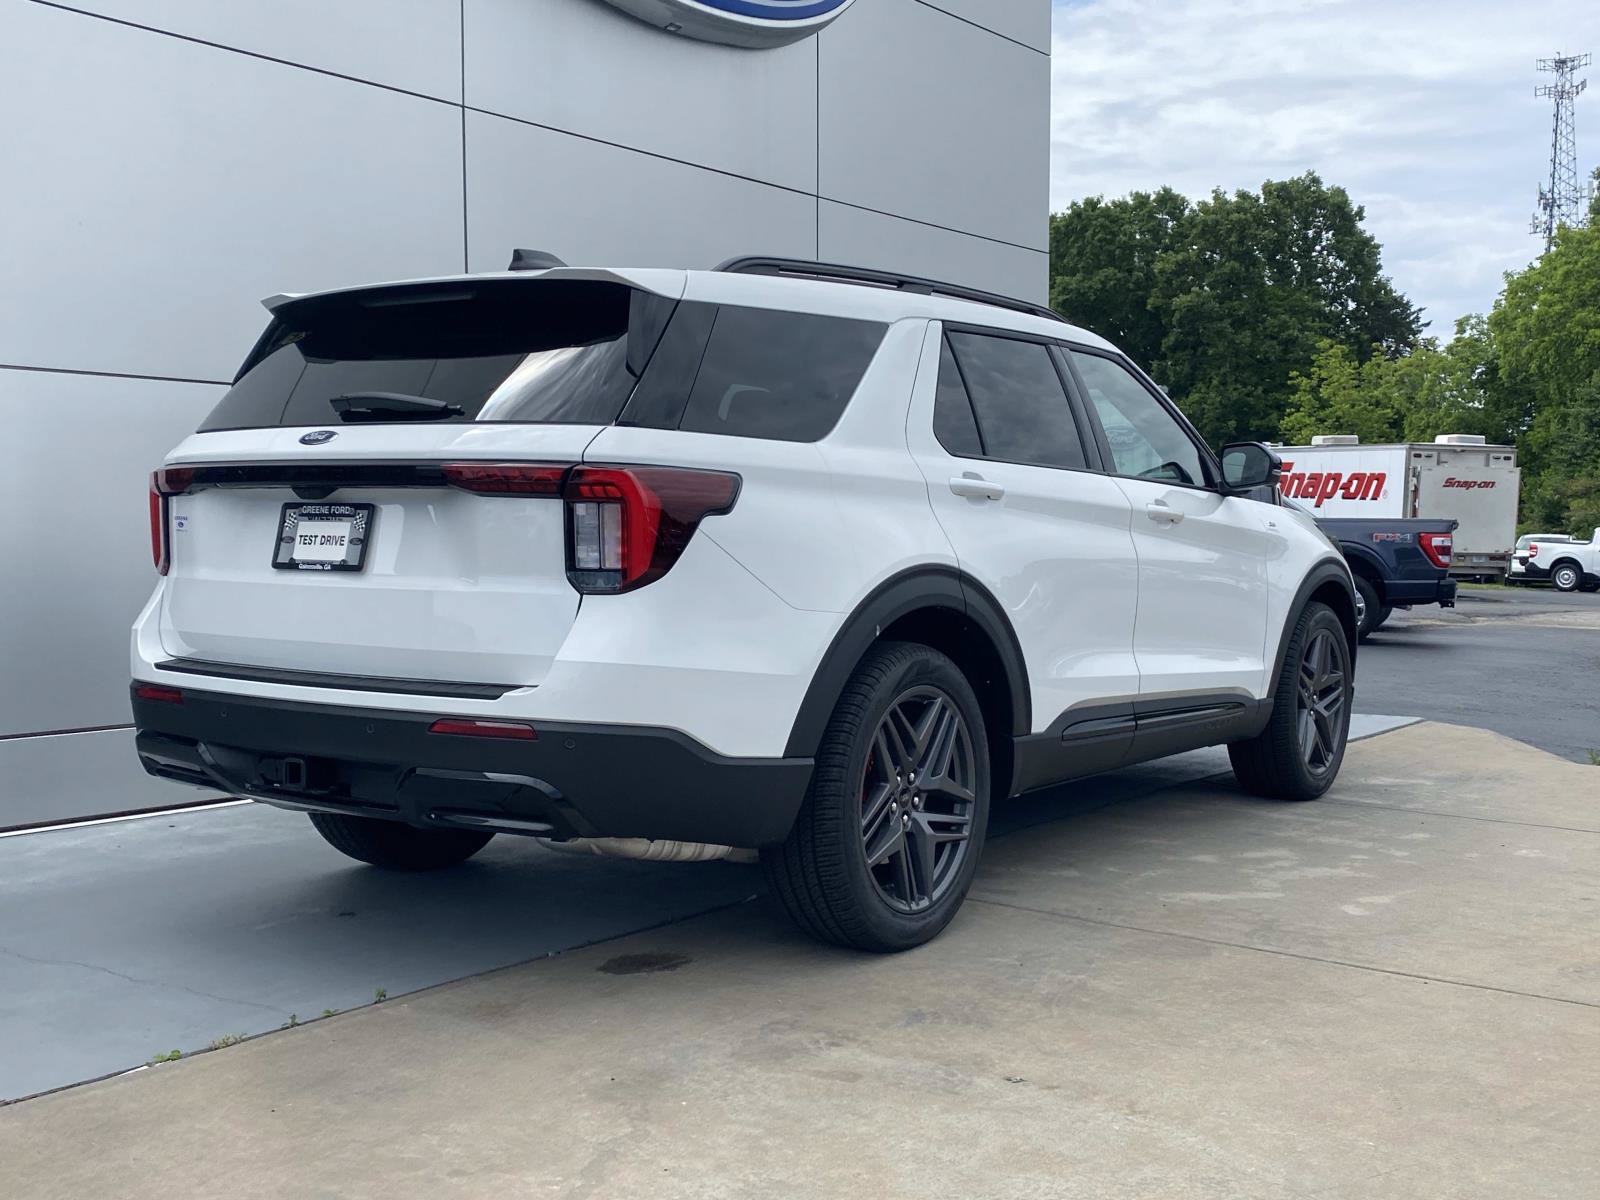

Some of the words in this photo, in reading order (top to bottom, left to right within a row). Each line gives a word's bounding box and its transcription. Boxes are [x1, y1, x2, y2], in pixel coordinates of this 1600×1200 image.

[1443, 477, 1496, 490] Snap-on
[302, 506, 329, 514] GREENE
[330, 506, 350, 514] FORD
[298, 534, 319, 545] TEST
[319, 535, 346, 546] DRIVE
